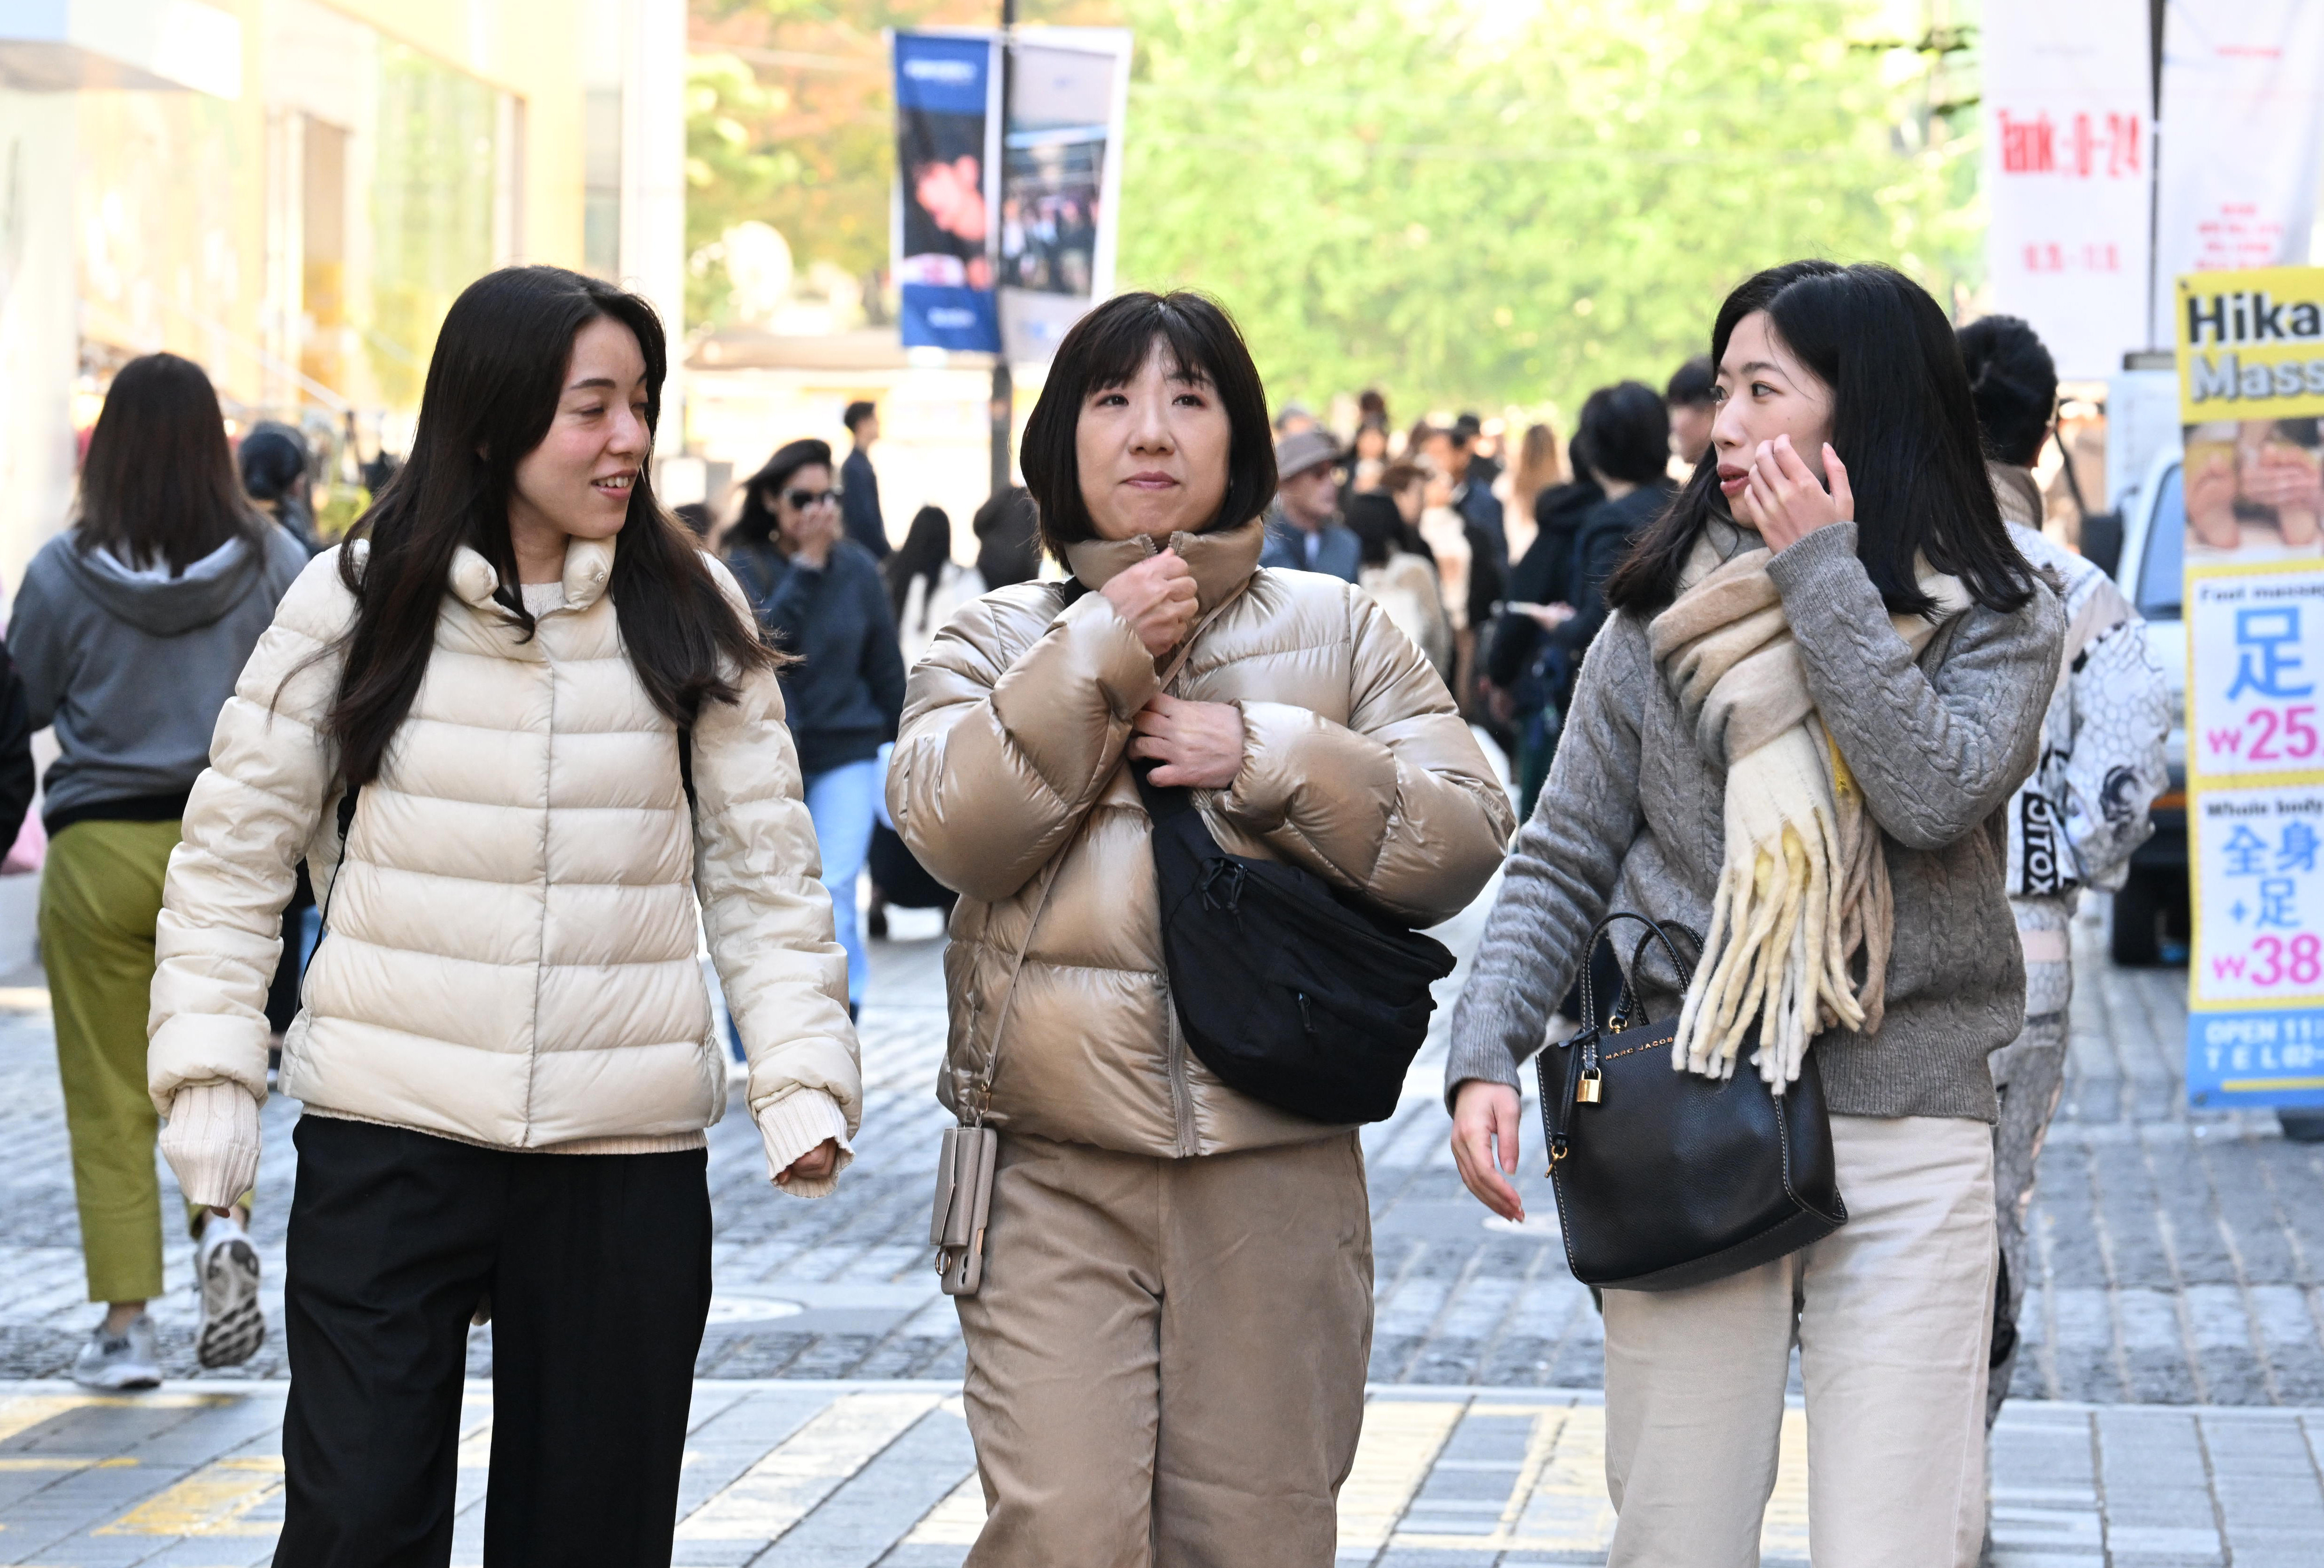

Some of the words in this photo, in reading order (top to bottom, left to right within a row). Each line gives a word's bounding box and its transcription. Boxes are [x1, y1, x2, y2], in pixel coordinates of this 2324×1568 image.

[2188, 293, 2321, 344] Hika
[2190, 354, 2324, 402] Mass
[2227, 607, 2314, 701] 足
[2223, 820, 2321, 876] 全身
[1605, 1047, 1633, 1060] MARC
[2205, 1018, 2278, 1044] OPEN
